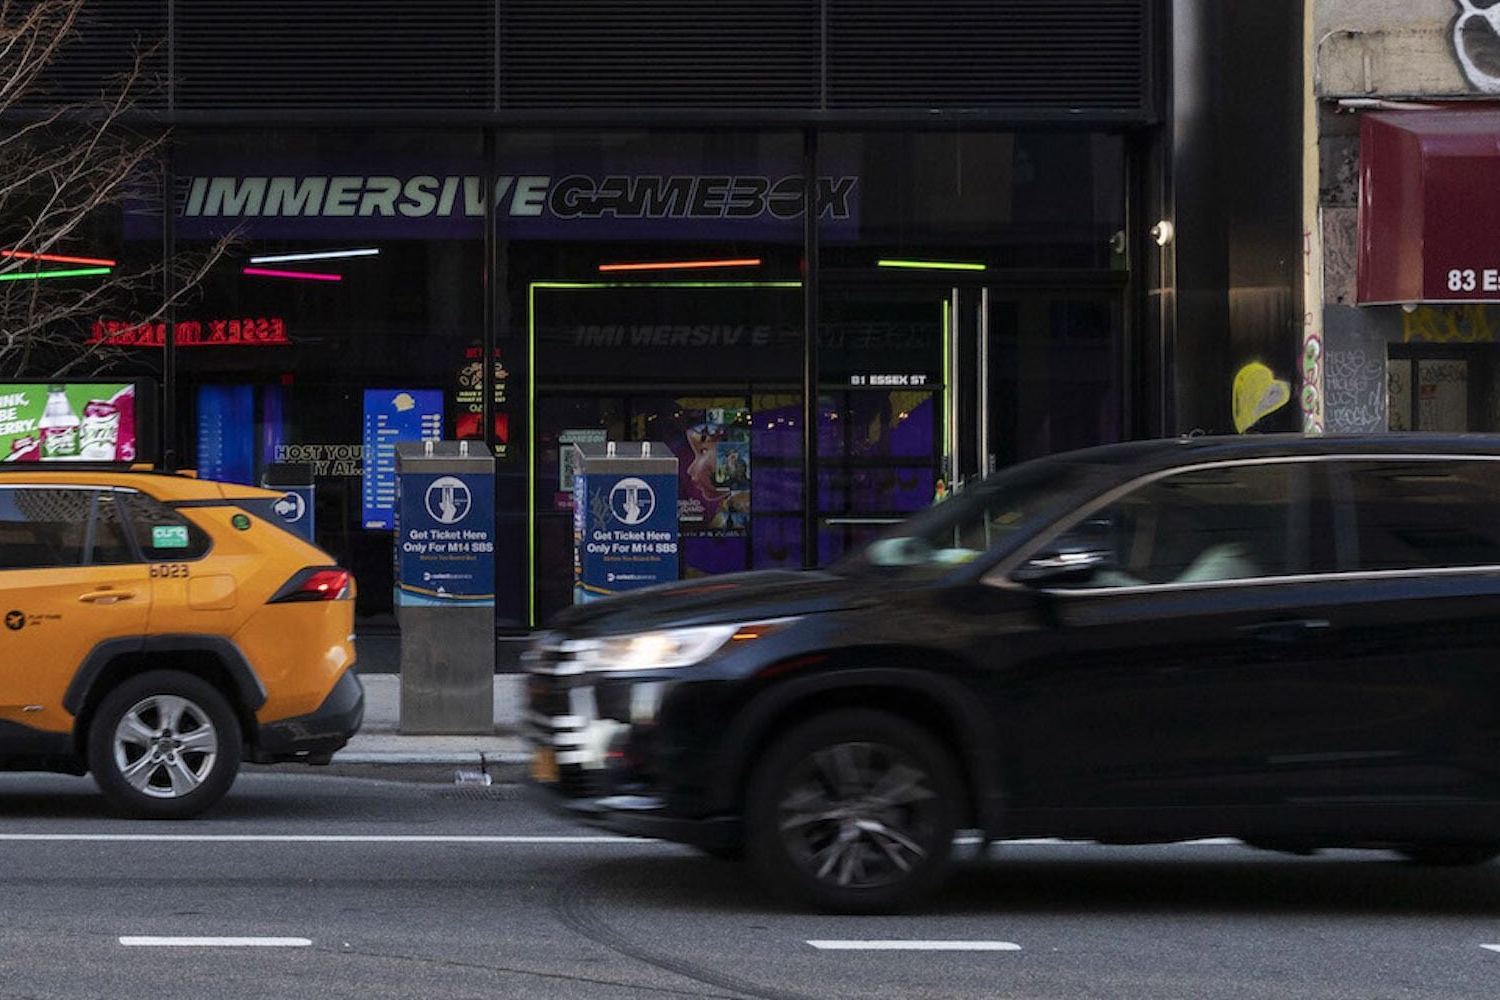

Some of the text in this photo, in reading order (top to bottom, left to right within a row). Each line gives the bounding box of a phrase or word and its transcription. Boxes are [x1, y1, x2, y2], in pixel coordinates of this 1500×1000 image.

[184, 175, 858, 220] IMMERSIVE GAMEBOX
[1447, 269, 1500, 291] 83 E
[869, 375, 908, 385] ESSEX
[910, 375, 926, 385] ST
[274, 445, 321, 460] HOST
[410, 530, 486, 540] Get Ticket Here
[595, 531, 613, 541] Get
[615, 531, 645, 541] Ticket
[647, 531, 671, 541] Here
[403, 542, 493, 553] Only For M14 SBS
[588, 543, 678, 554] Only For M14 SBS
